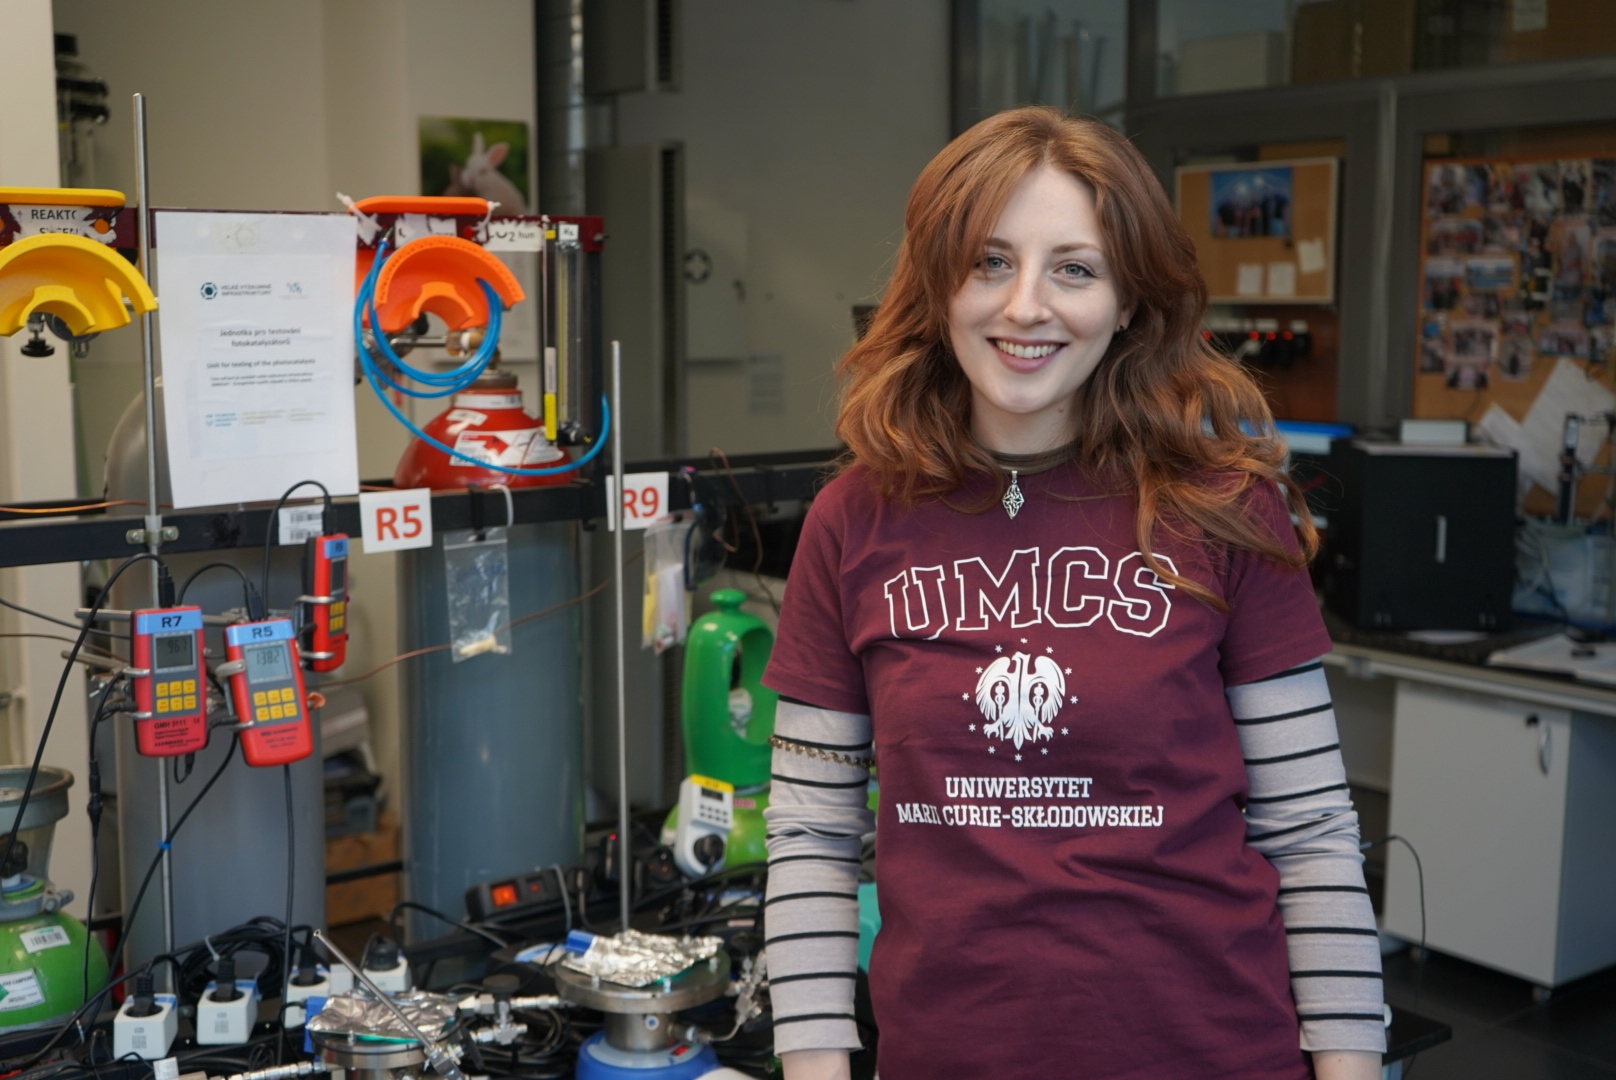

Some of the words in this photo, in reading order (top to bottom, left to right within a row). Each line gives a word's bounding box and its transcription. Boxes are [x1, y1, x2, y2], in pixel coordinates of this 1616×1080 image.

[623, 487, 659, 519] R9
[375, 504, 423, 542] R5
[883, 545, 1179, 641] UMCS
[161, 615, 183, 628] R7
[252, 625, 273, 639] R5
[945, 776, 1093, 799] UNIWERSYTET
[896, 802, 943, 826] MARII
[942, 804, 1165, 828] CURIE-SKŁODOWSKIEJ
